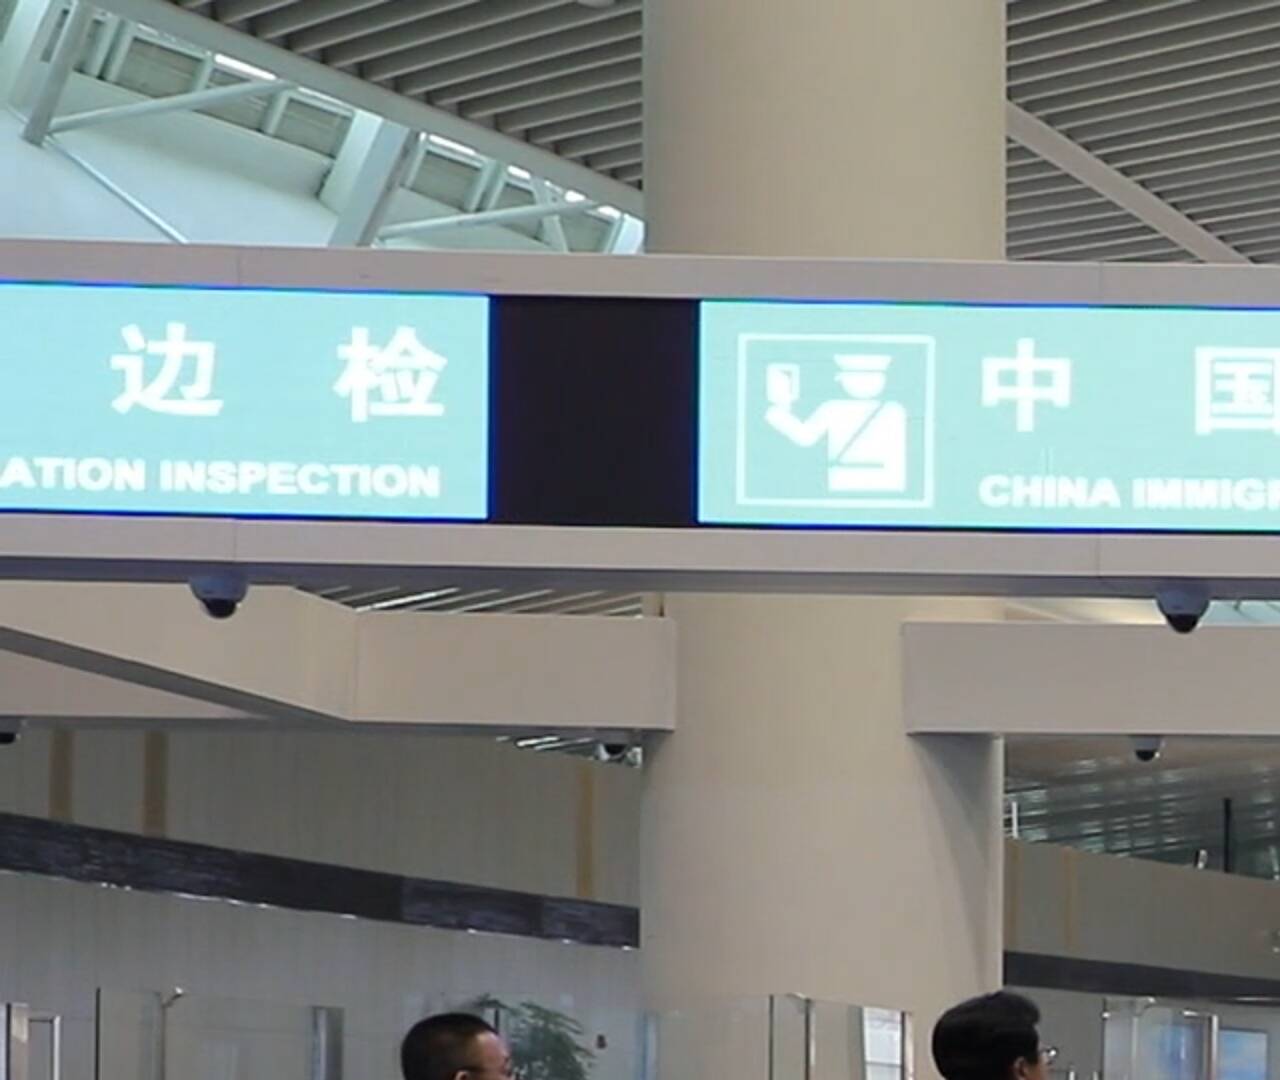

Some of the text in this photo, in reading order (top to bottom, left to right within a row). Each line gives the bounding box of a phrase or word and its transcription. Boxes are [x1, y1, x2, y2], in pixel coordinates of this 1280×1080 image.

[110, 322, 449, 423] 边检
[160, 461, 441, 498] INSPECTION
[979, 475, 1121, 507] CHINA
